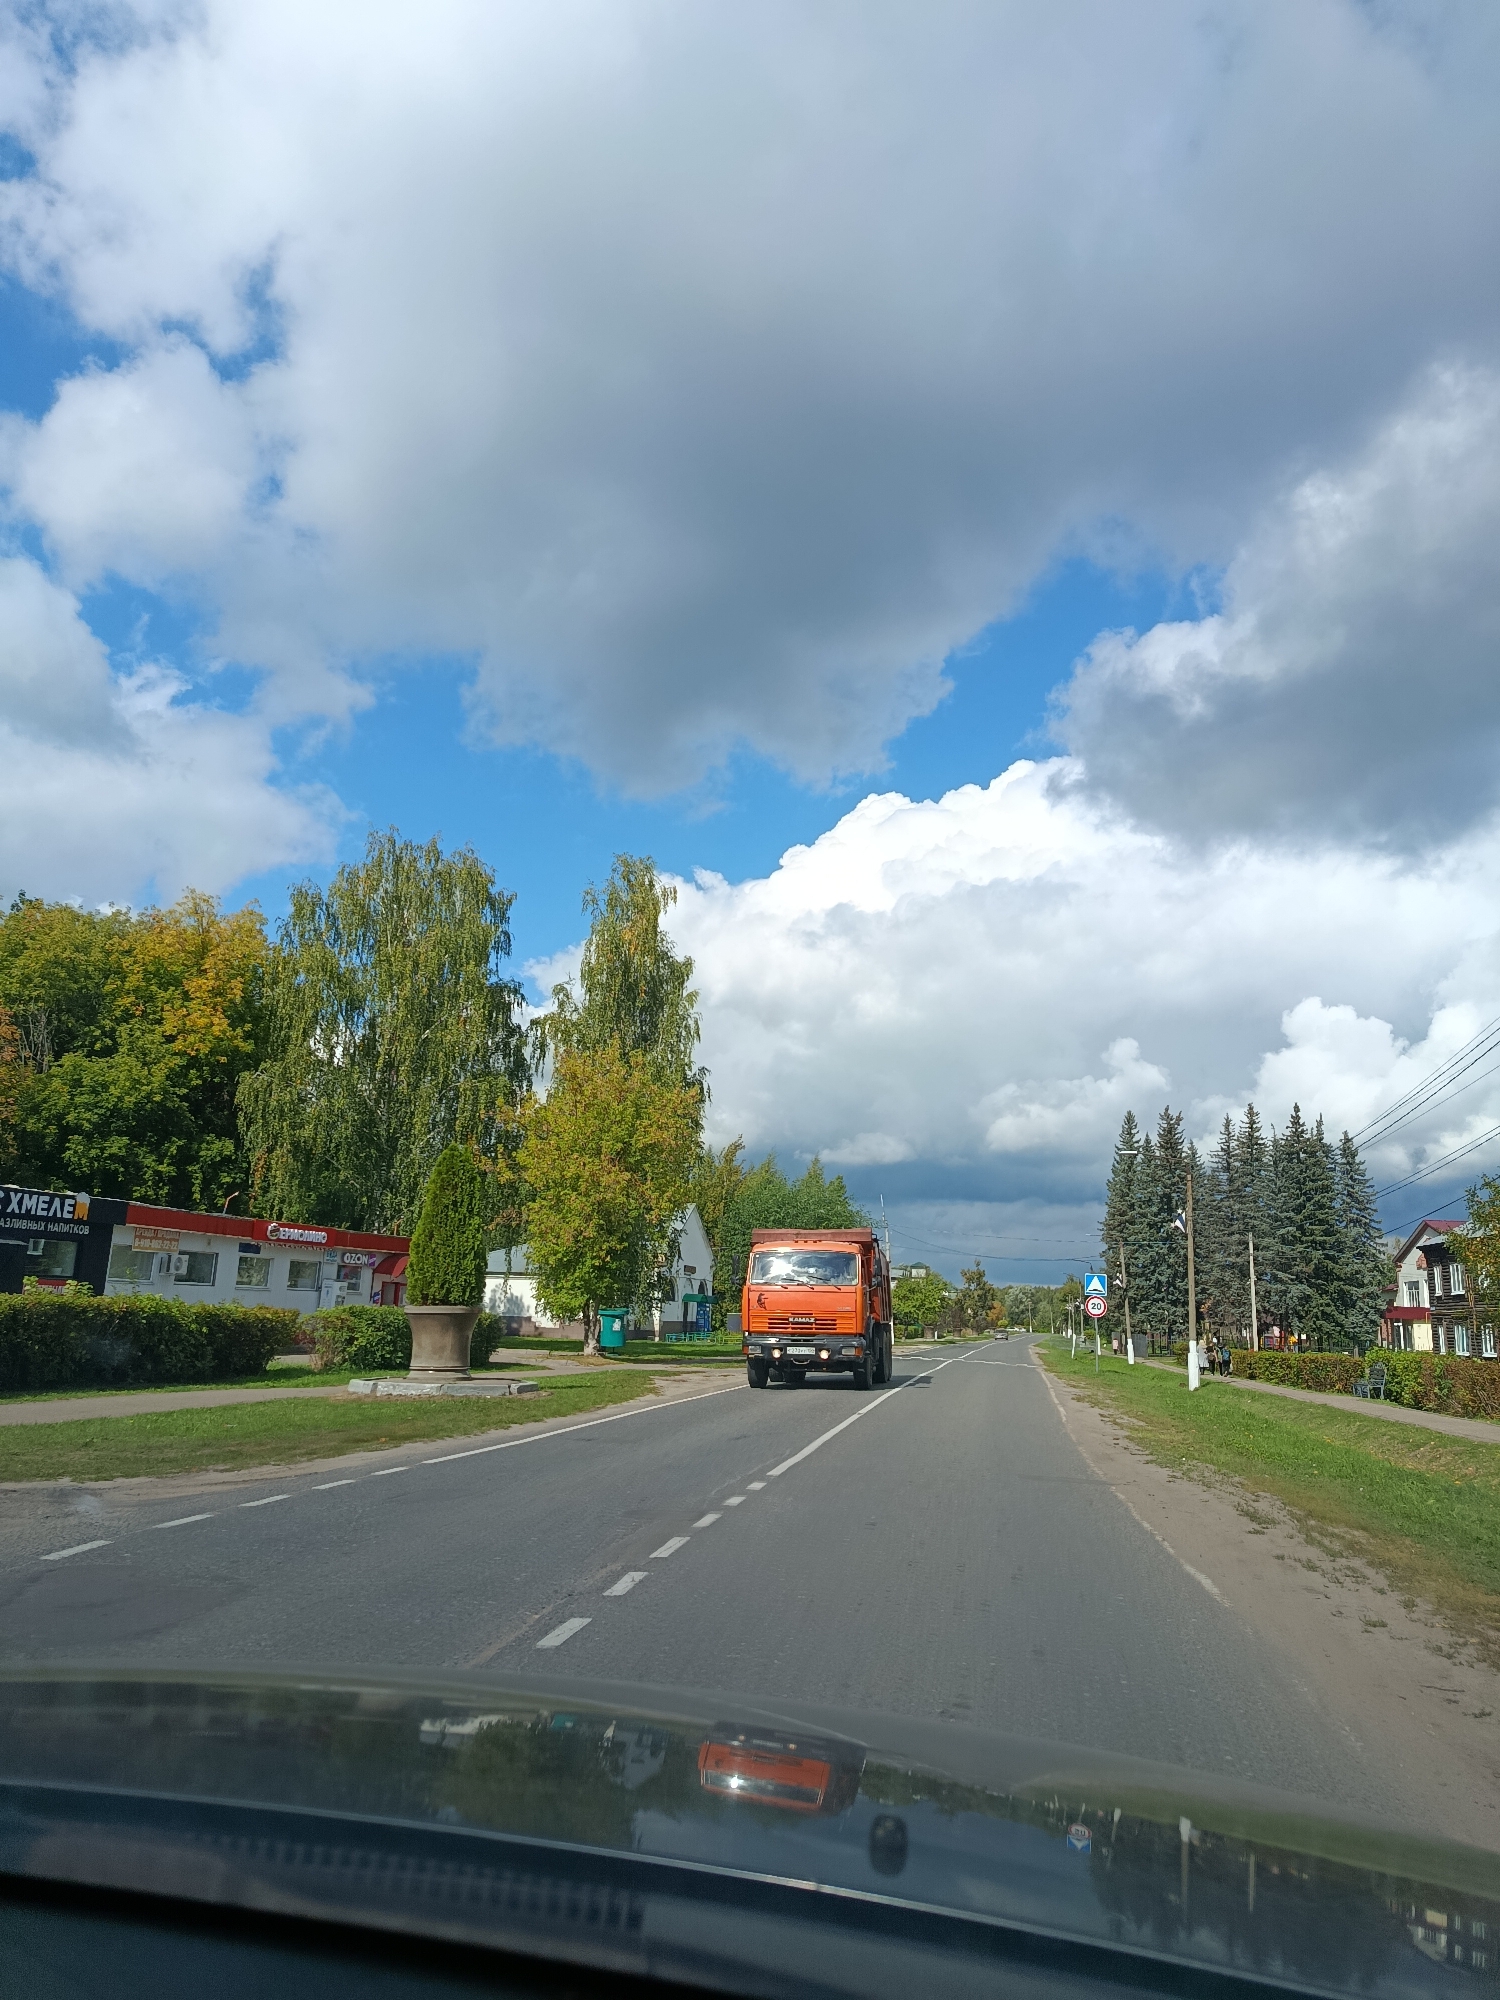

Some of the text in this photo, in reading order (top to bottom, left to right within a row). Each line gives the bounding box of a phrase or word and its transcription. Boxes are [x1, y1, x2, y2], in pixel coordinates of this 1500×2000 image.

[6, 1192, 88, 1220] ХМЕЛЕМ
[47, 1221, 90, 1235] НАПИТКОВ
[344, 1253, 368, 1265] OZON
